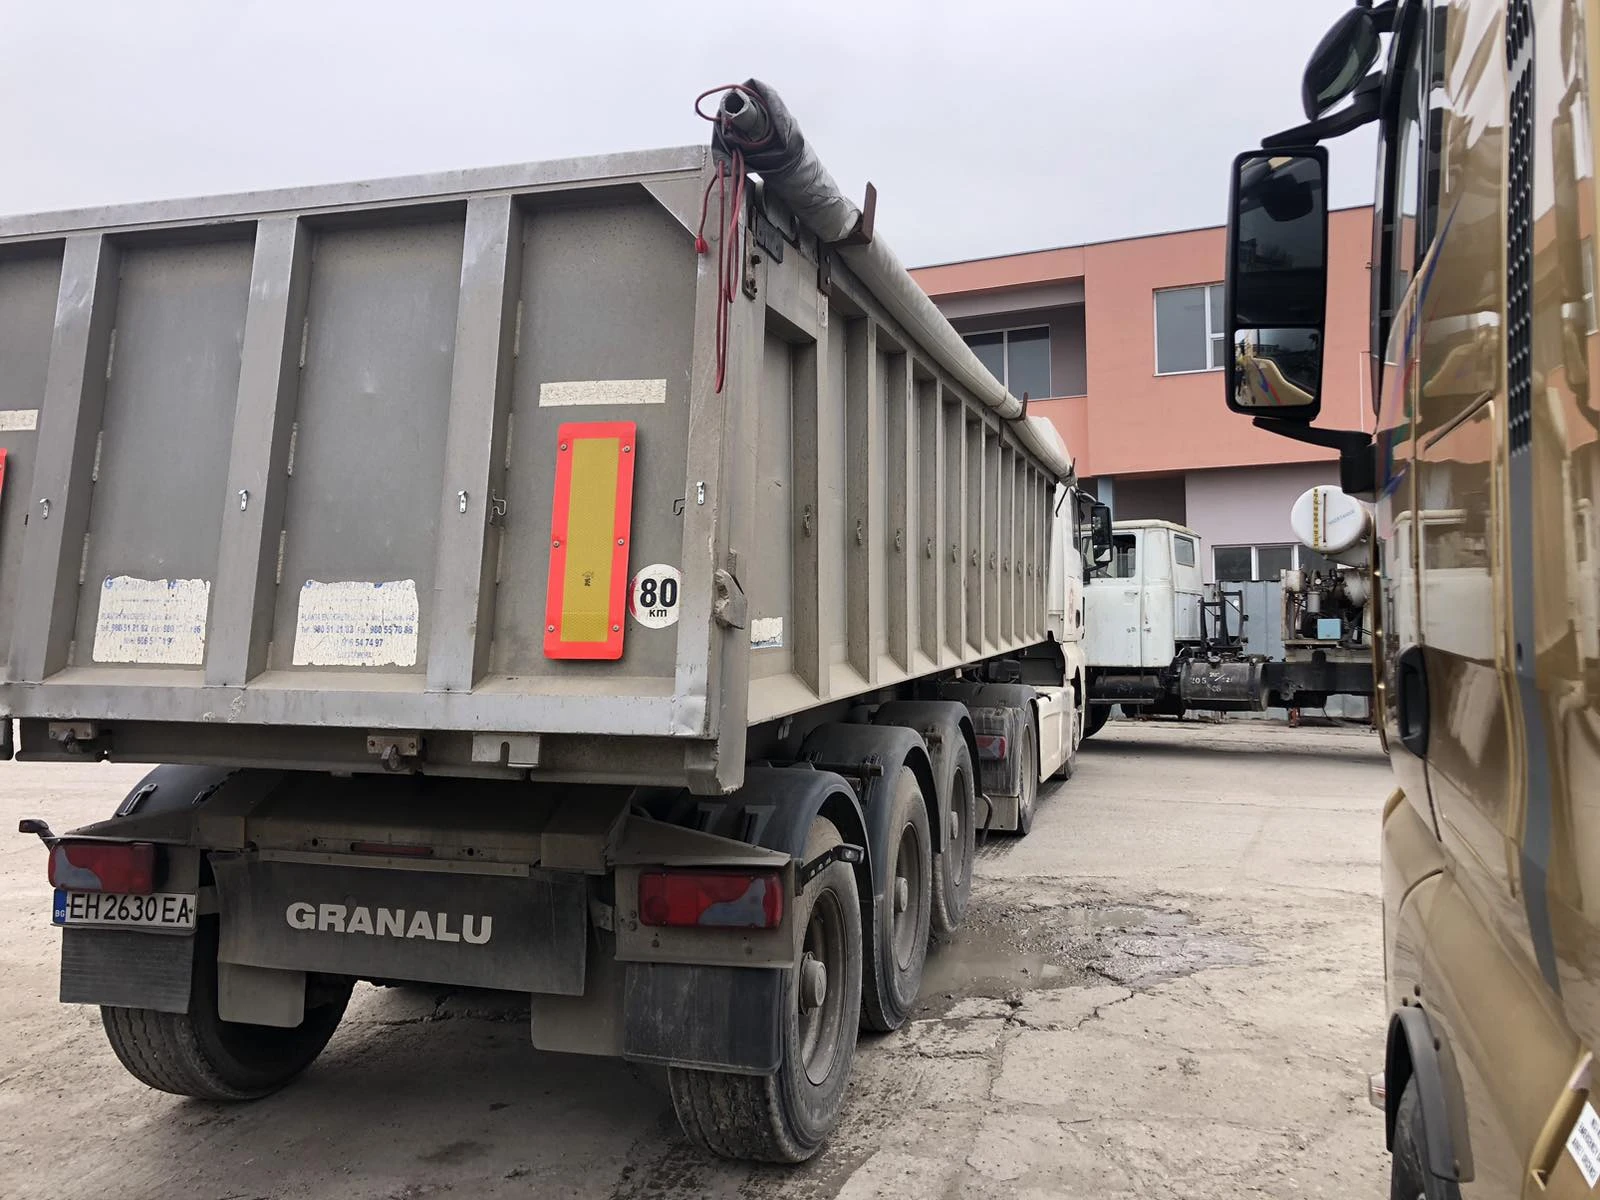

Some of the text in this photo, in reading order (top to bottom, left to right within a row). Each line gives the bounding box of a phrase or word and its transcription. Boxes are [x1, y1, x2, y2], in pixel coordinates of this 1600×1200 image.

[640, 578, 677, 608] 80
[55, 909, 65, 917] BG
[103, 895, 157, 921] 2630
[286, 902, 493, 944] GRANALU
